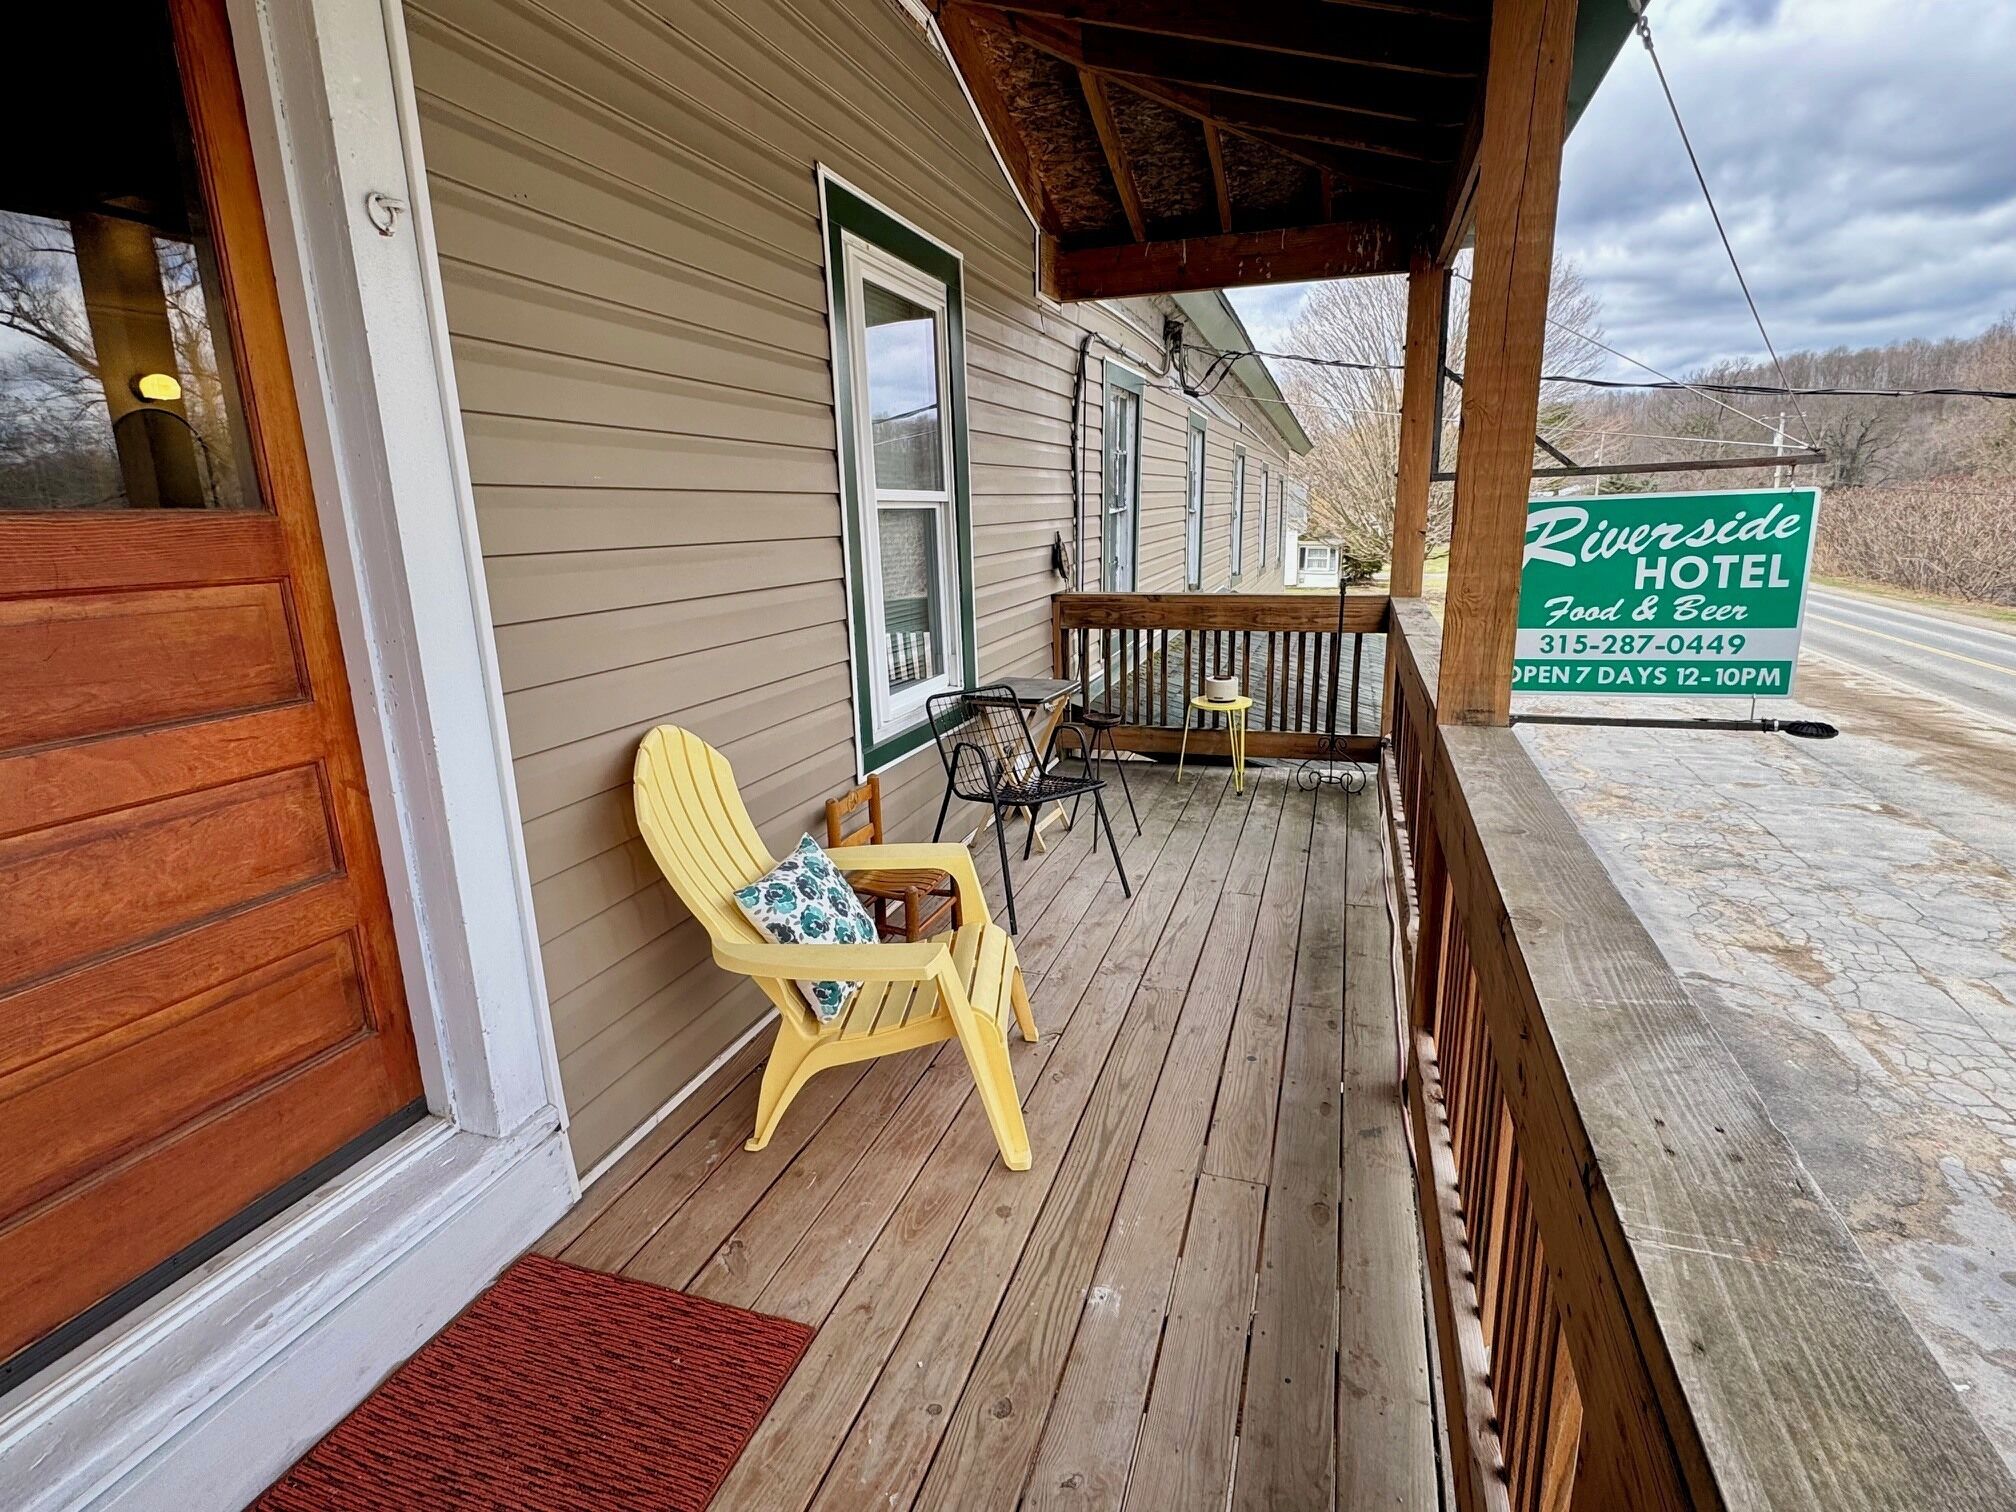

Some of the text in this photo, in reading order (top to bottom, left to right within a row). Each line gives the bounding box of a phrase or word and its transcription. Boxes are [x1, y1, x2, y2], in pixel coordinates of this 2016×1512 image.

[1522, 503, 1800, 568] Riverside
[1634, 554, 1789, 590] HOTEL
[1544, 595, 1748, 626] Food & Beer
[1540, 634, 1746, 655] 315-287-0449
[1575, 666, 1592, 684] 7
[1598, 667, 1667, 686] DAYS
[1677, 667, 1780, 686] 12-10PM
